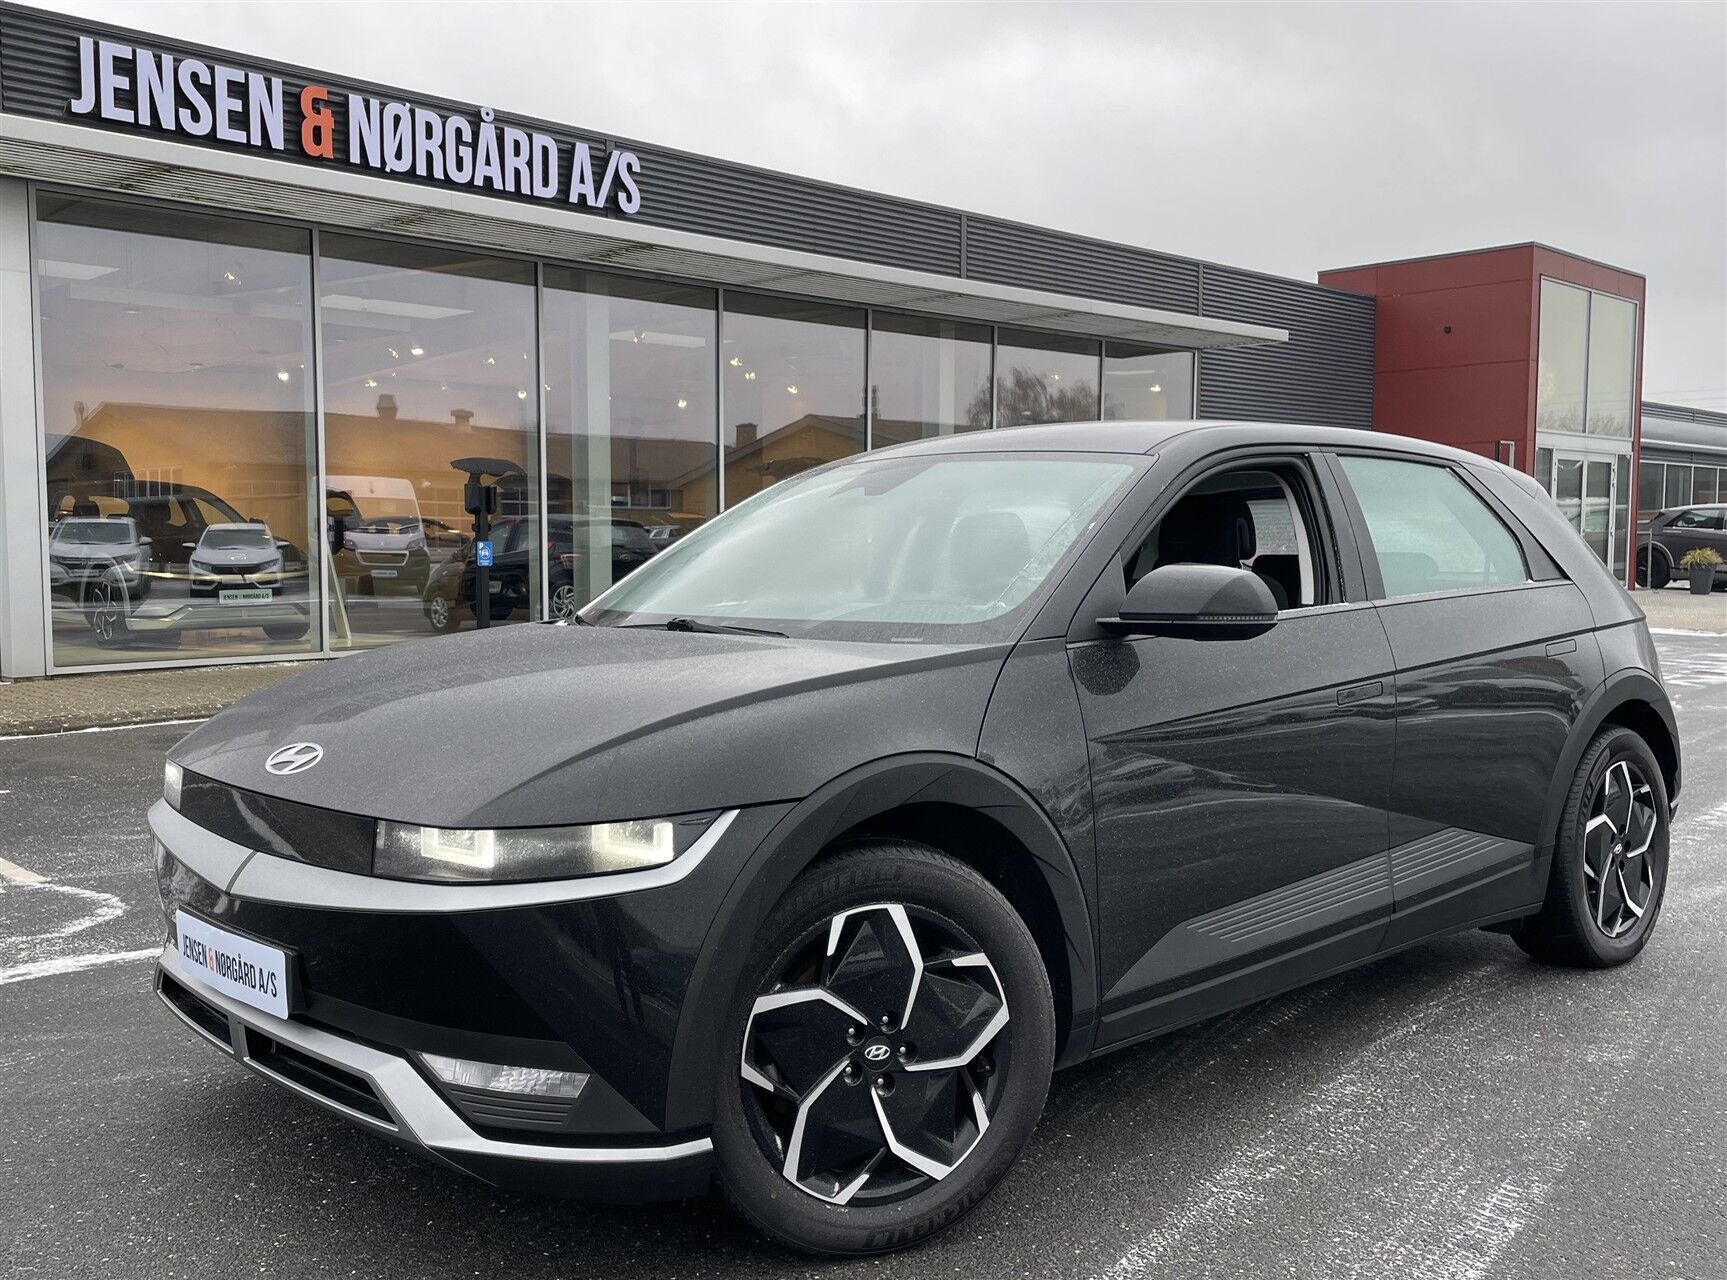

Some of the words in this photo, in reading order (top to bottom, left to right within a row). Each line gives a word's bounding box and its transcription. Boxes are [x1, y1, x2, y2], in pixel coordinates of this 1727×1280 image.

[71, 36, 284, 150] JENSEN
[301, 86, 334, 159] &
[349, 94, 558, 198] NØRGÅRD
[569, 142, 641, 214] A/S
[183, 934, 208, 968] JENSEN
[208, 947, 216, 971] &
[215, 950, 256, 989] NØRGÅRD
[259, 967, 277, 998] A/S
